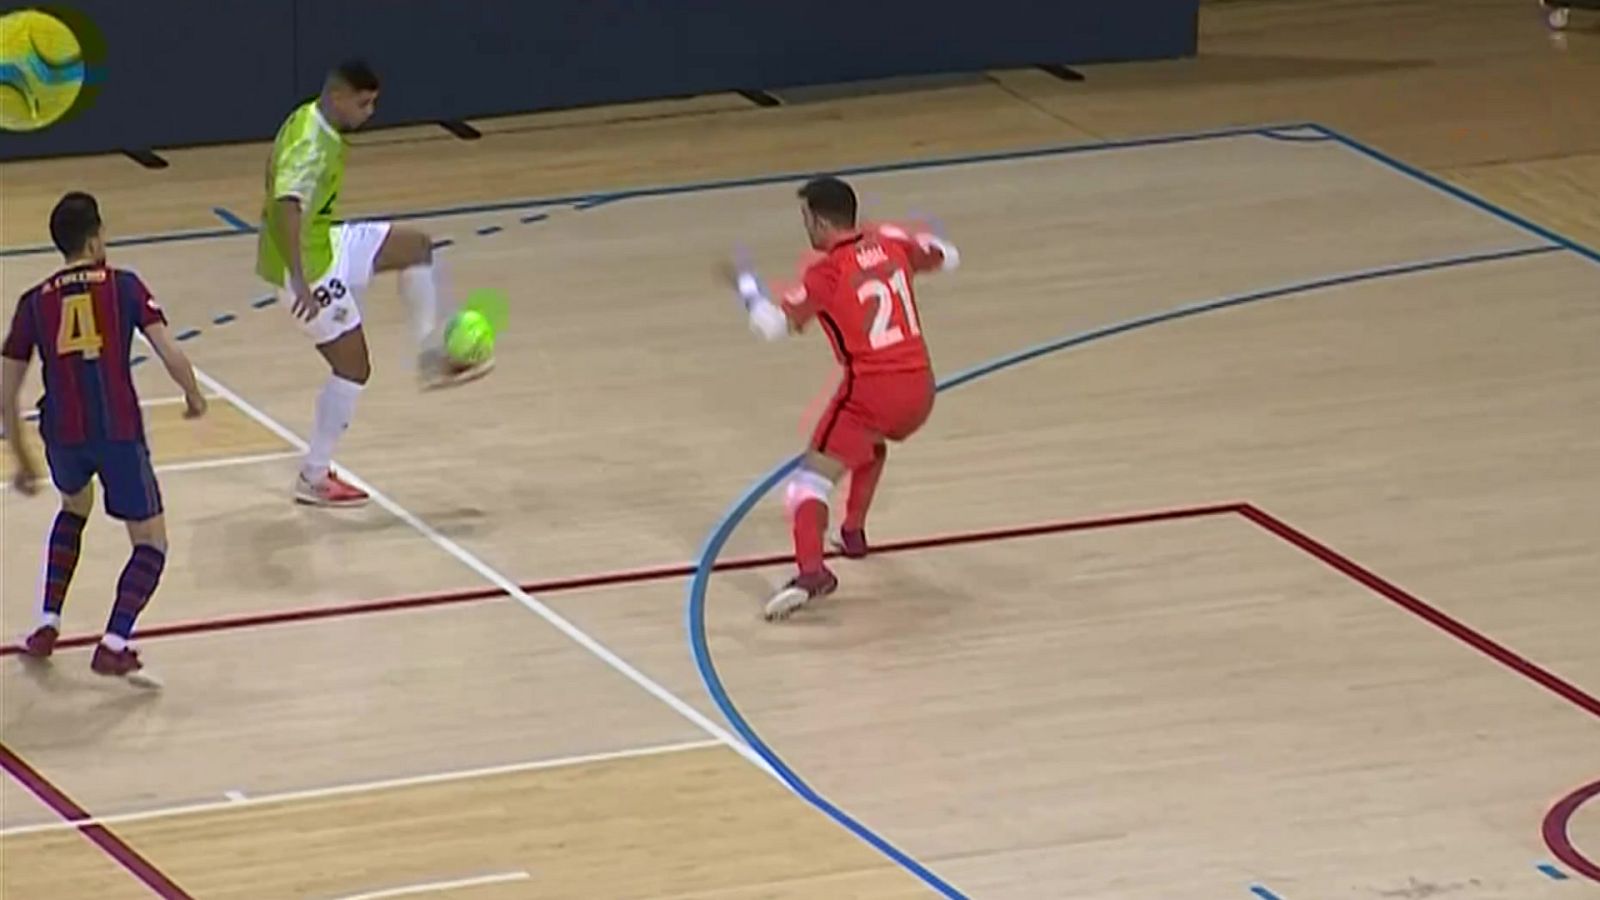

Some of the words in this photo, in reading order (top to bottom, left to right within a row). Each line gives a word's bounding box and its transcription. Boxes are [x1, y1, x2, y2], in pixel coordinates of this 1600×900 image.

[313, 278, 346, 308] 93
[857, 268, 920, 349] 21
[57, 294, 103, 358] 4
